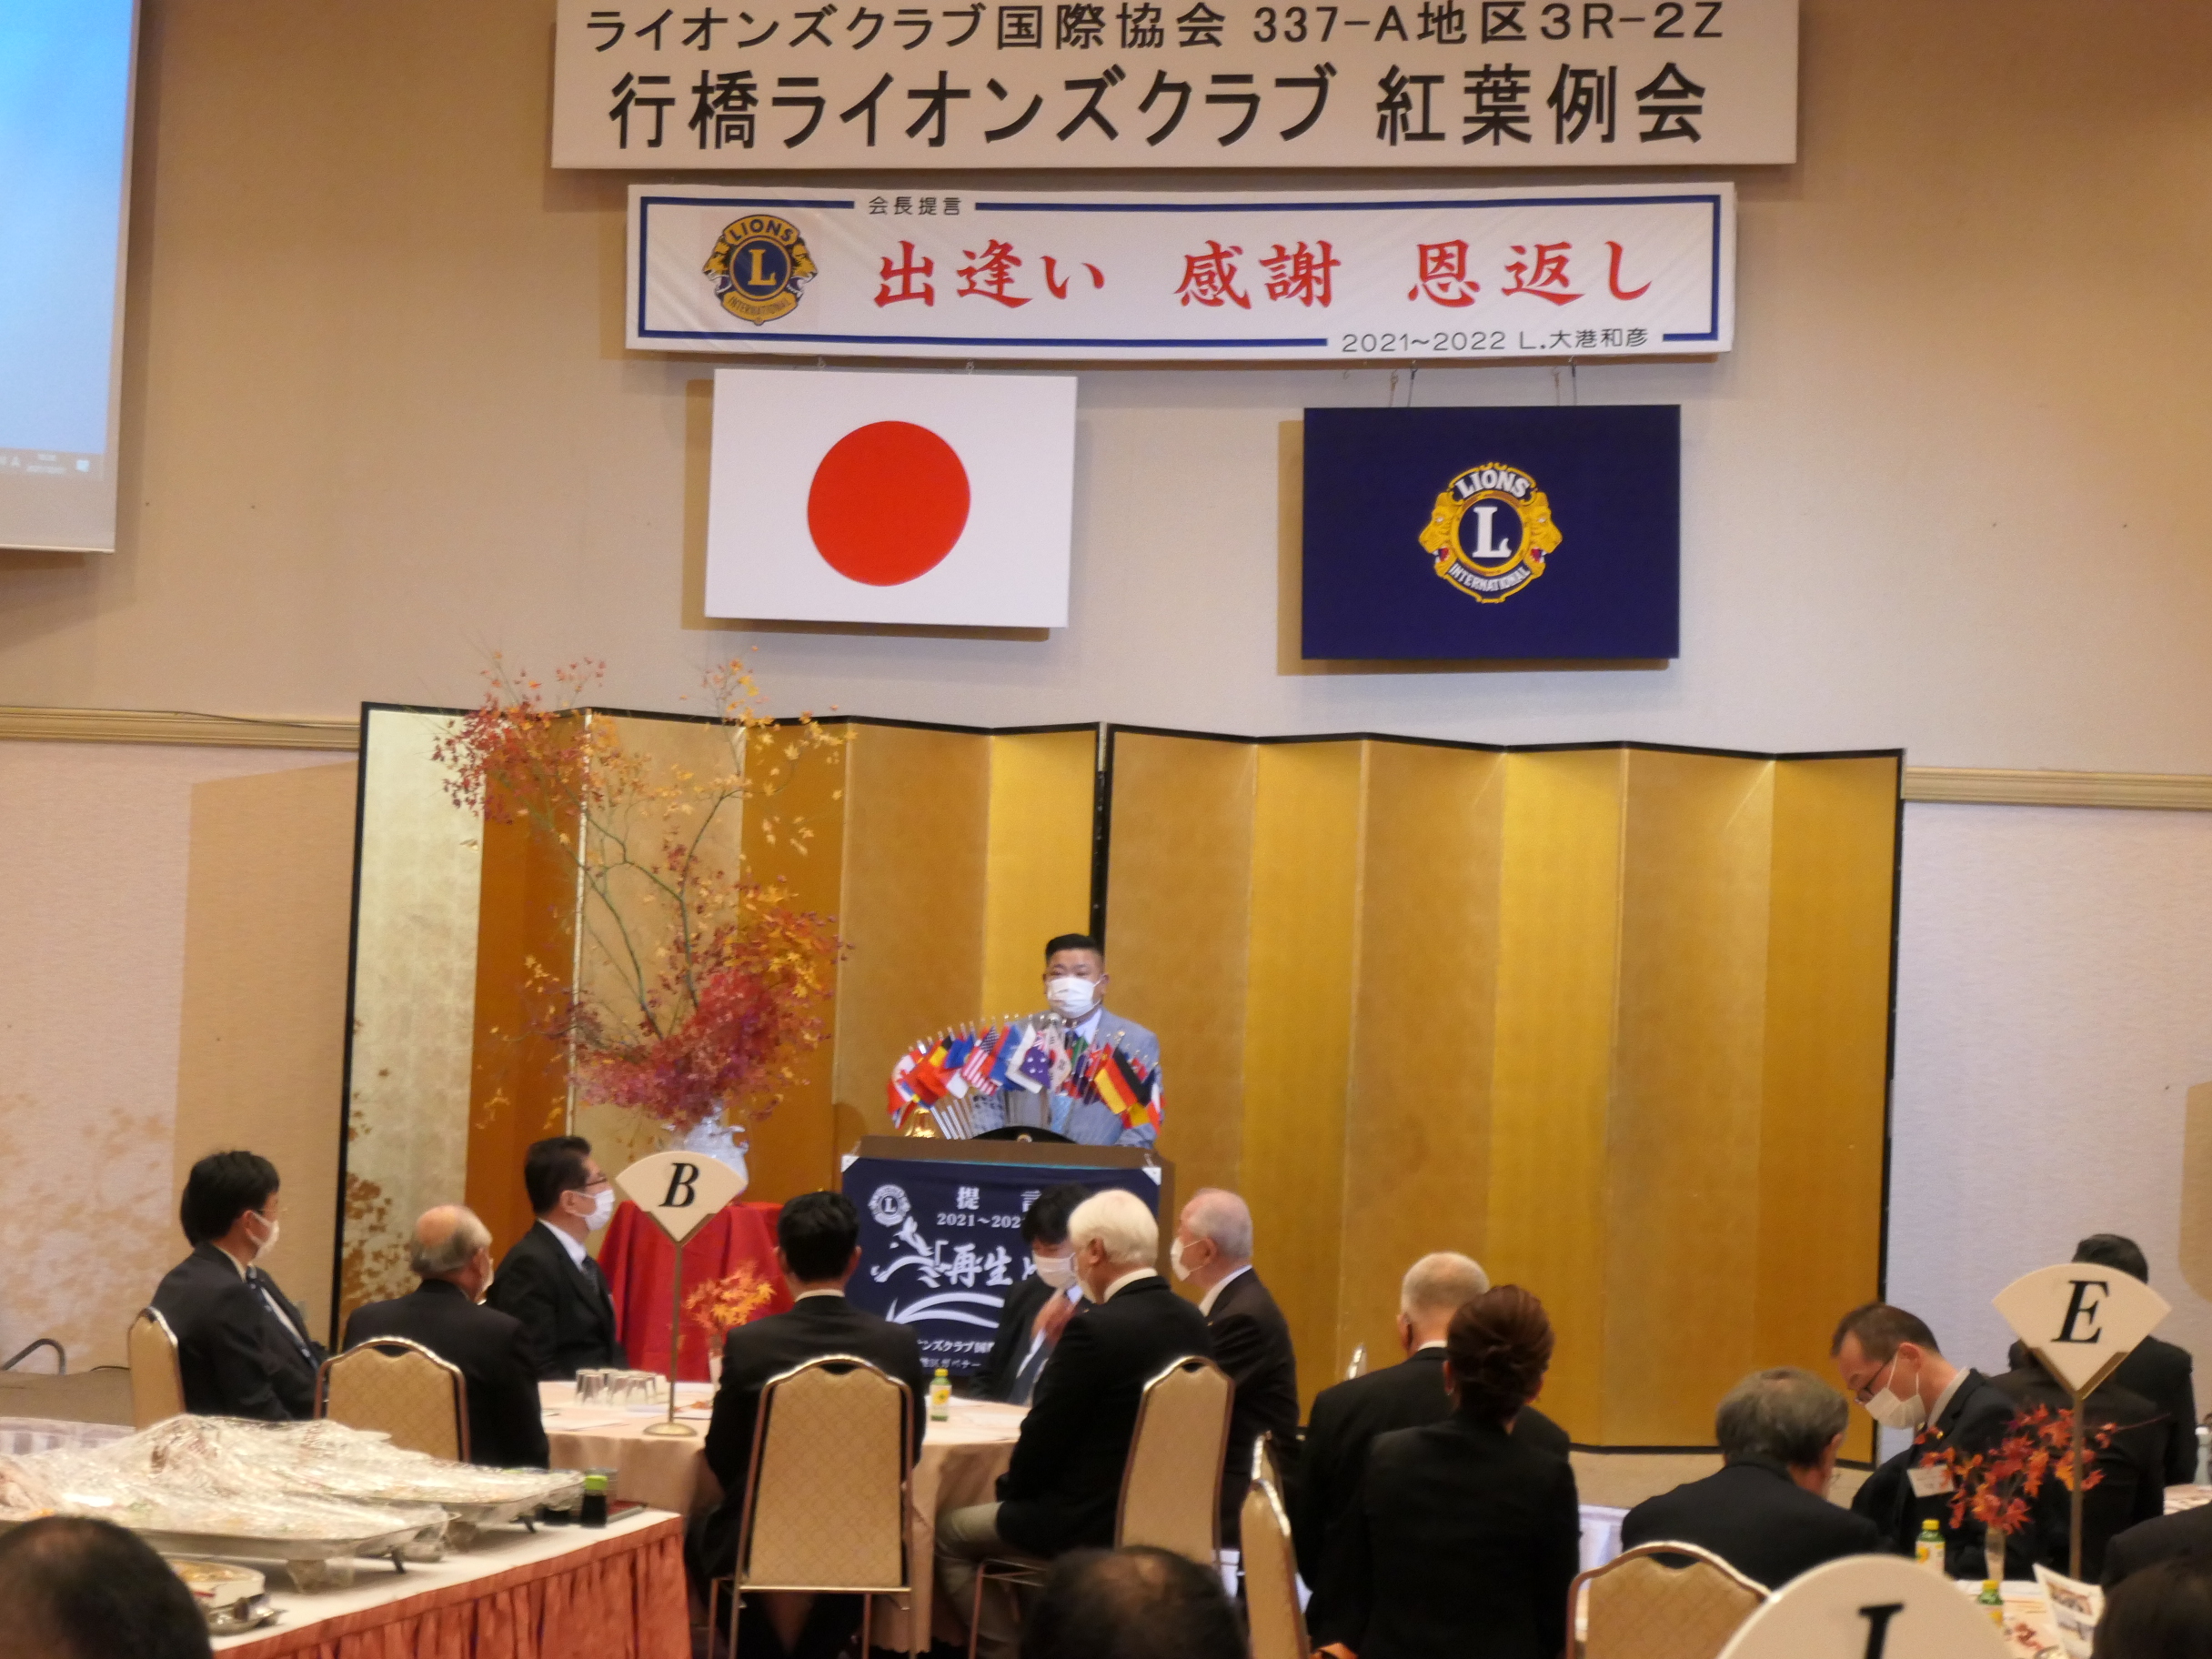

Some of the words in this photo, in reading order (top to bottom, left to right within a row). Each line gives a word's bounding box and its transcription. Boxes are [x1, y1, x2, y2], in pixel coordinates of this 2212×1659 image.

[587, 2, 1226, 52] ライオンズクラブ国際協会
[608, 62, 1339, 150] 行橋ライオンズクラブ
[1376, 63, 1706, 146] 紅葉例会
[868, 196, 962, 216] 会長提言
[729, 219, 793, 241] LIONS
[748, 248, 777, 286] L
[873, 239, 1106, 309] 出逢い
[1174, 239, 1342, 310] 感謝
[1407, 238, 1653, 308] 恩返し
[1455, 468, 1531, 498] LIONS
[1472, 506, 1512, 558] L
[1448, 562, 1532, 591] INTERNATIONAL
[659, 1162, 699, 1208] B
[2051, 1280, 2109, 1343] E
